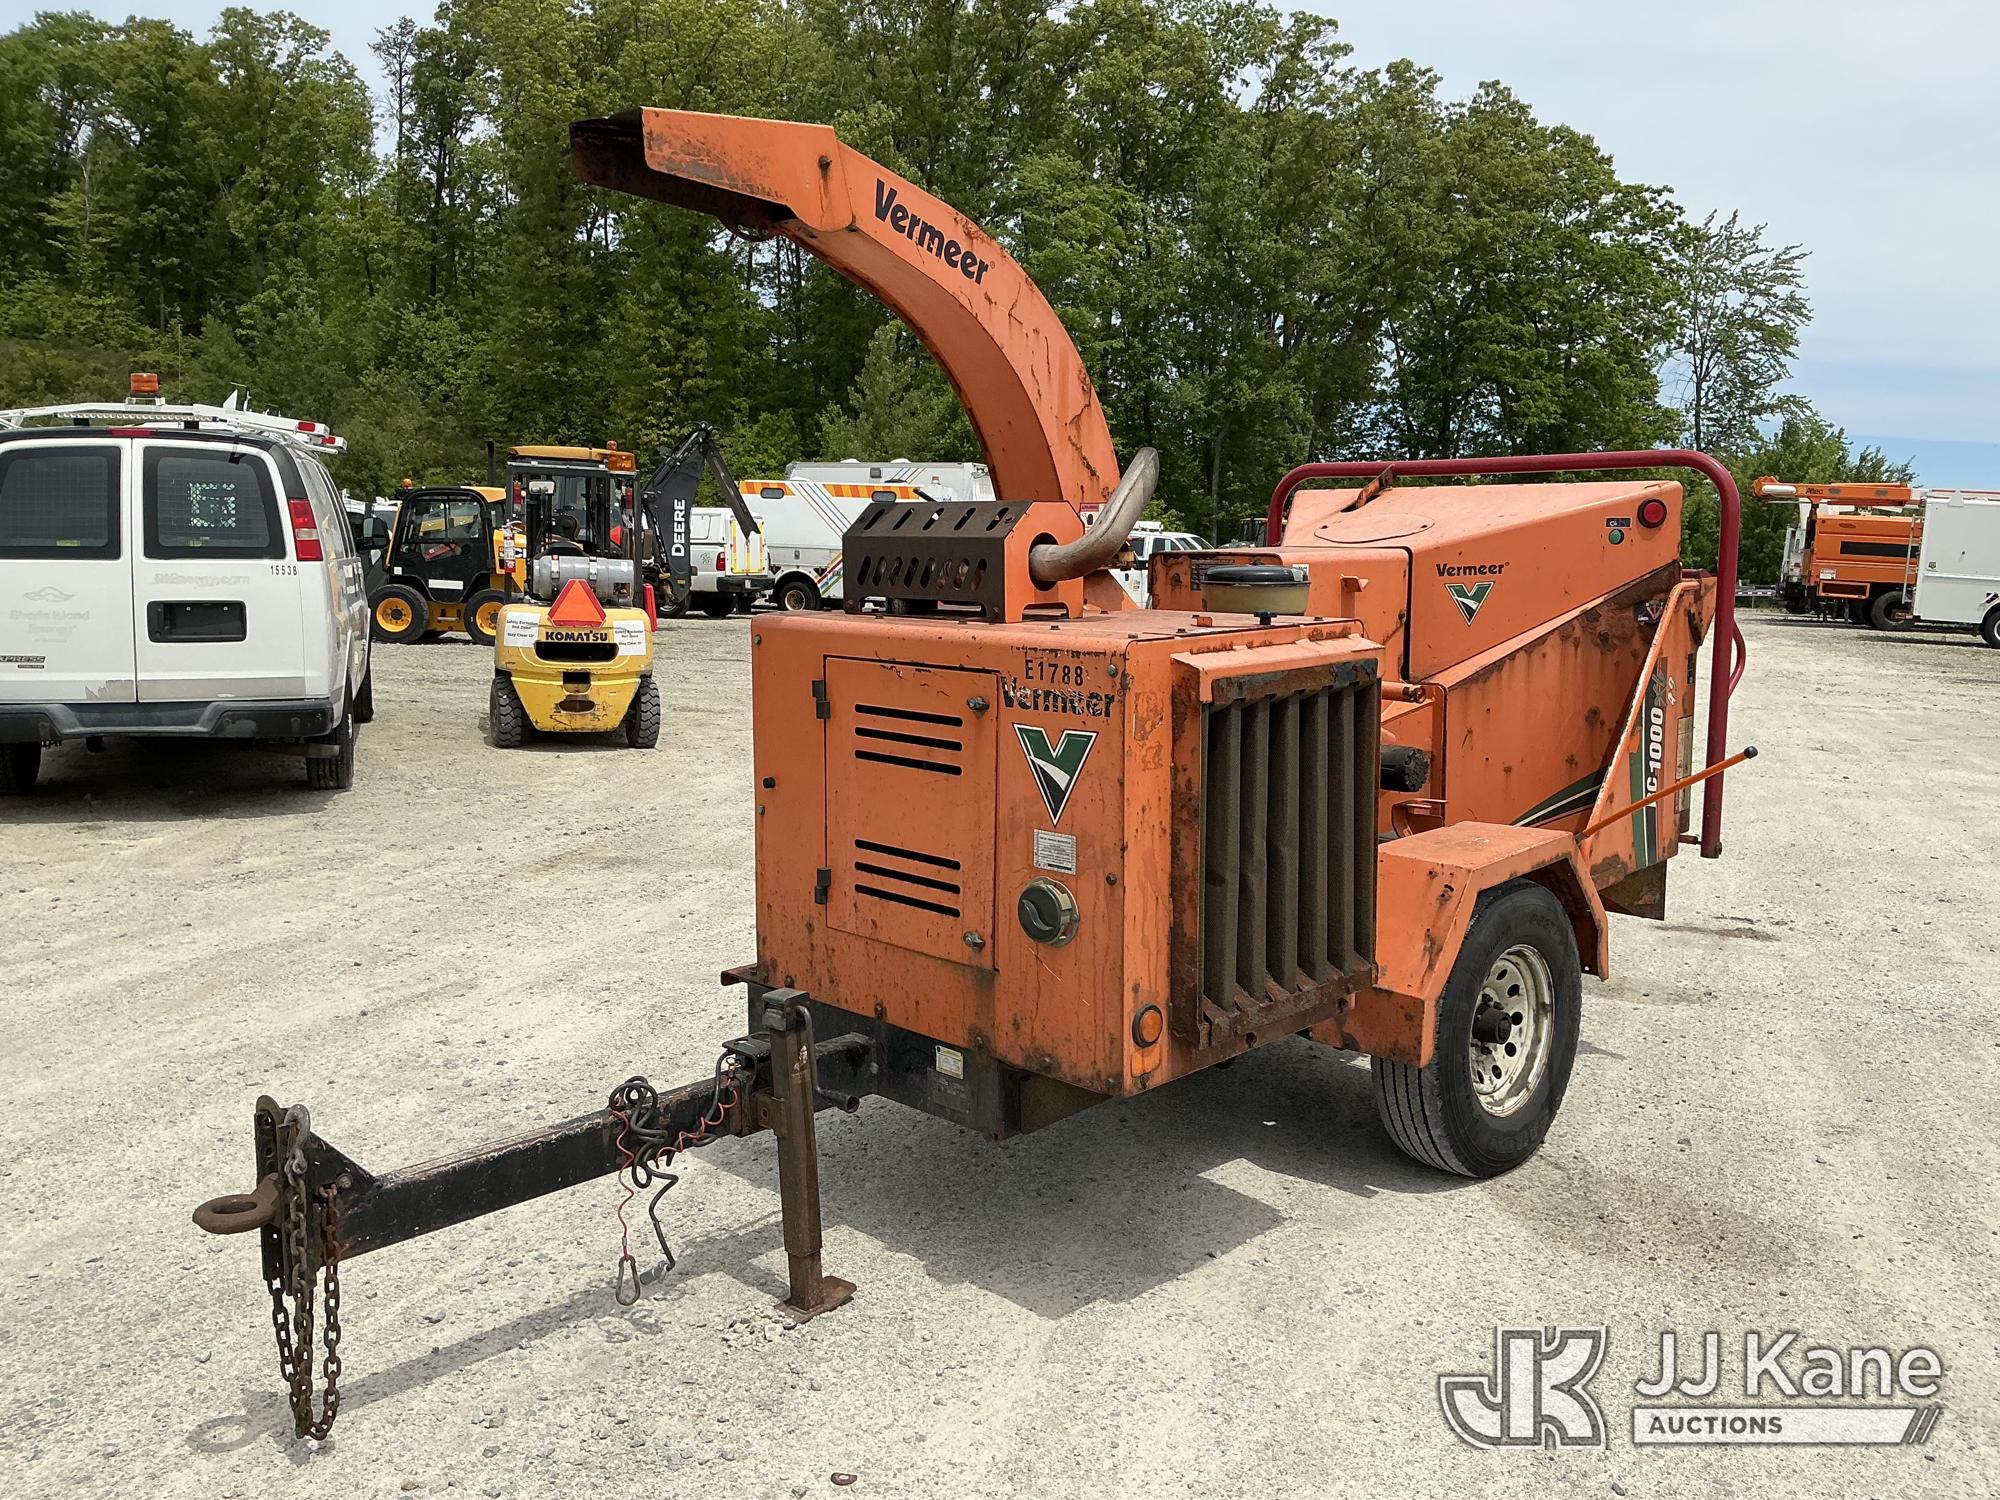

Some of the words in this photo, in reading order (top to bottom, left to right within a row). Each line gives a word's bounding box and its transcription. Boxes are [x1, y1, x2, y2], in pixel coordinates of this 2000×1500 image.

[874, 178, 989, 285] Vermeer
[1805, 487, 1824, 495] Altec
[671, 499, 686, 557] DEERE
[270, 565, 298, 576] 15538
[1436, 562, 1505, 577] Vermeer
[545, 630, 608, 641] KOMATSU
[1025, 659, 1083, 686] E1788
[1000, 676, 1115, 717] Vermeer
